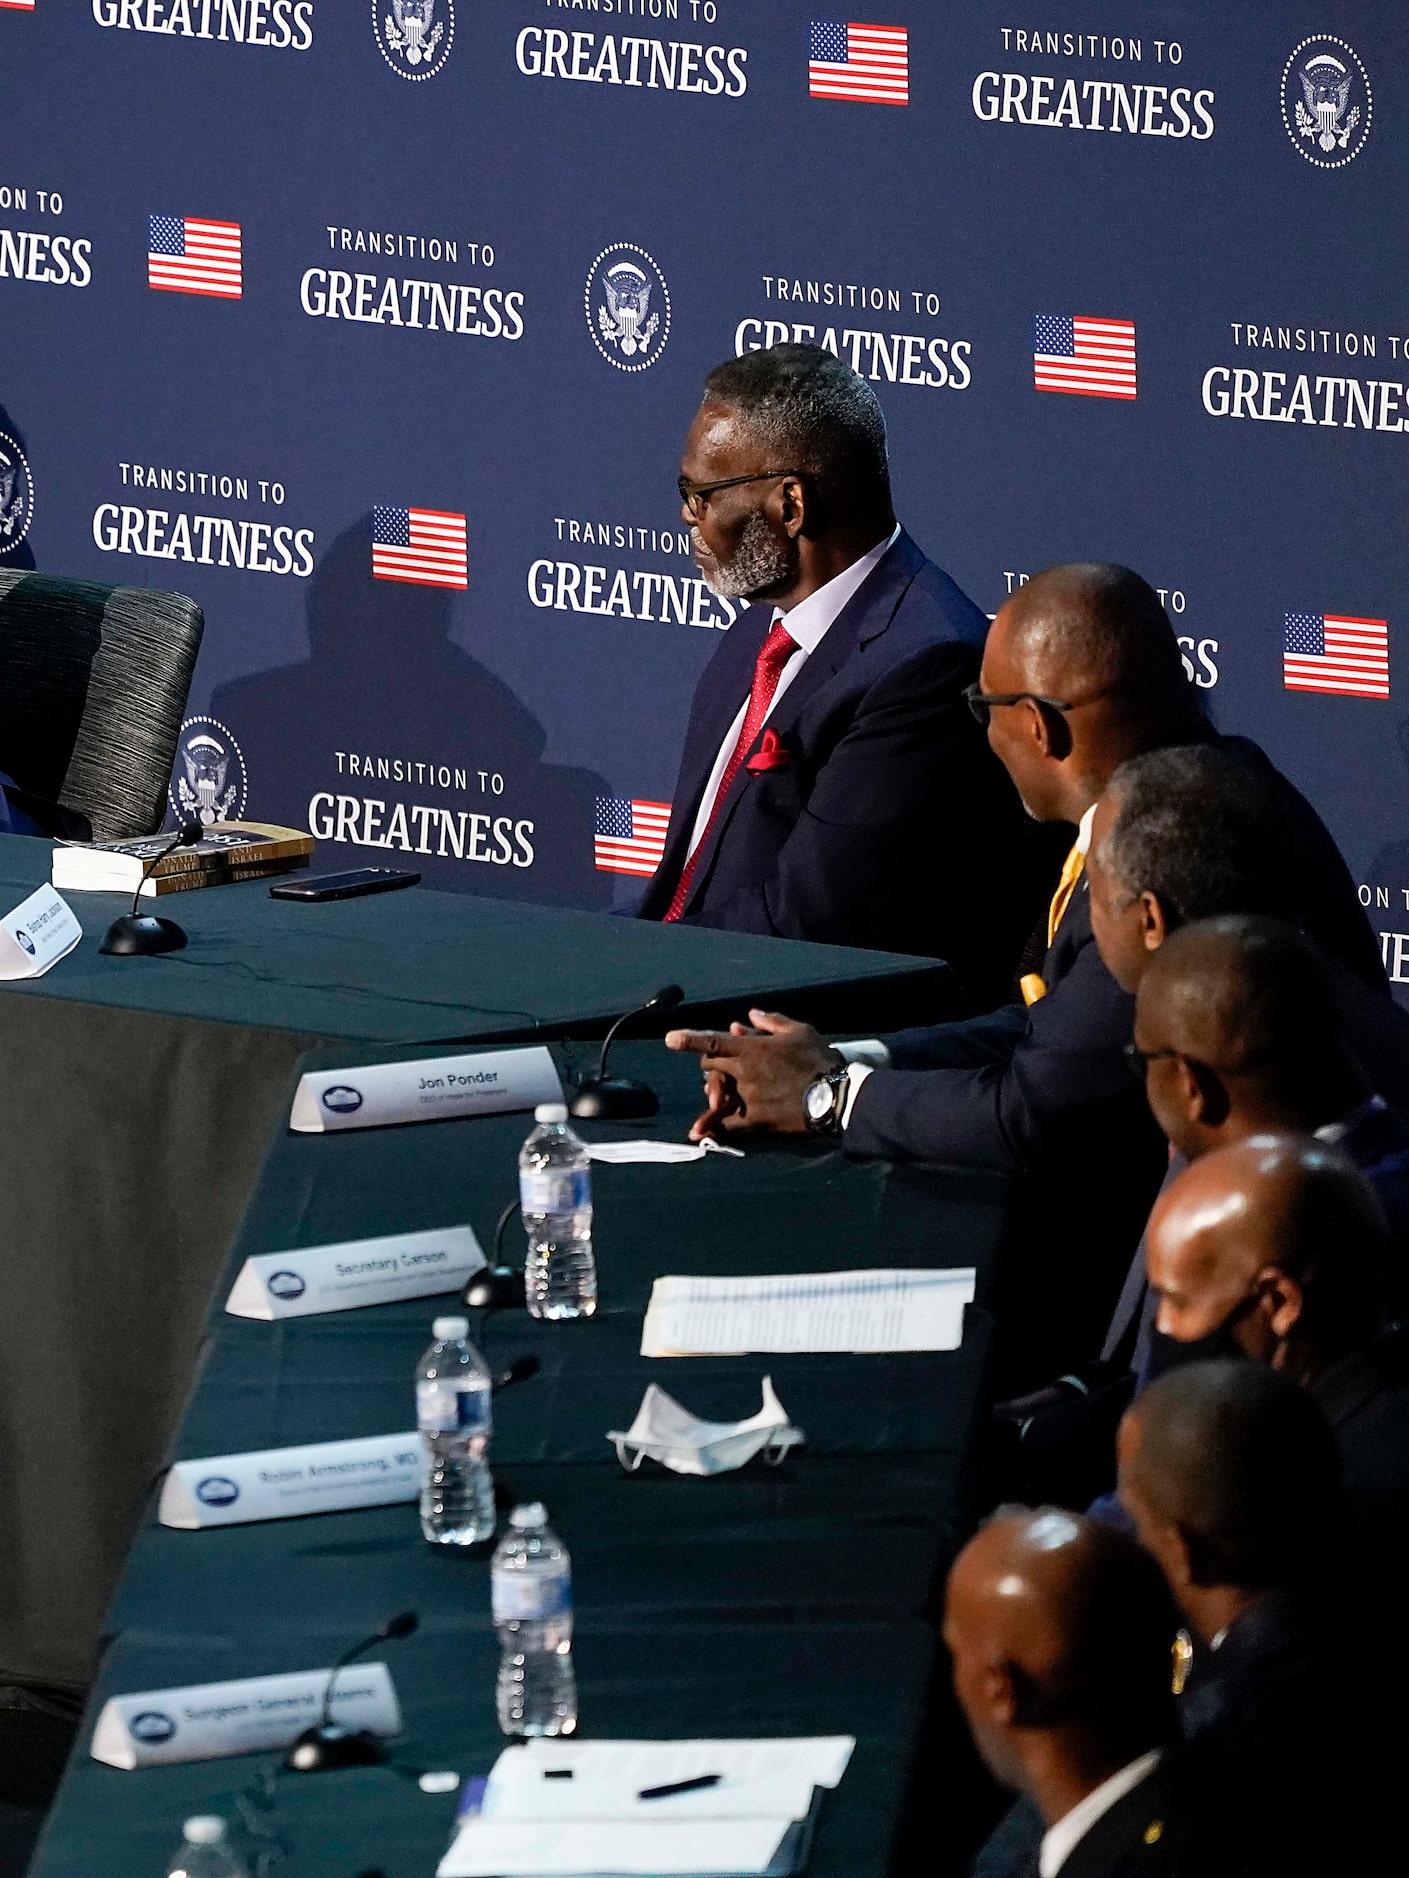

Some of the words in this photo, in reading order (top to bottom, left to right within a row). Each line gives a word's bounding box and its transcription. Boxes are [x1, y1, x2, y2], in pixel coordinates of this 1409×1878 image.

[91, 0, 314, 51] GREATNESS
[689, 0, 717, 24] TO
[515, 26, 748, 97] GREATNESS
[1000, 28, 1142, 62] TRANSITION
[1153, 40, 1183, 65] TO
[972, 71, 1215, 140] GREATNESS
[36, 190, 63, 215] TO
[326, 226, 458, 263] TRANSITION
[467, 243, 495, 267] TO
[300, 267, 524, 340] GREATNESS
[762, 276, 900, 312] TRANSITION
[911, 291, 940, 316] TO
[1230, 323, 1377, 357] TRANSITION
[118, 462, 248, 501] TRANSITION
[257, 480, 285, 505] TO
[92, 502, 315, 577] GREATNESS
[554, 517, 691, 556] TRANSITION
[527, 559, 752, 631] GREATNES
[1156, 588, 1186, 614] TO
[335, 751, 467, 790] TRANSITION
[477, 771, 504, 795] TO
[307, 792, 535, 868] GREATNESS
[164, 862, 198, 874] TRUMP
[231, 853, 264, 865] ISRAEL
[418, 1077, 444, 1090] Jon
[447, 1072, 498, 1086] Ponder
[335, 1258, 398, 1277] Secretary
[400, 1252, 447, 1267] Carson
